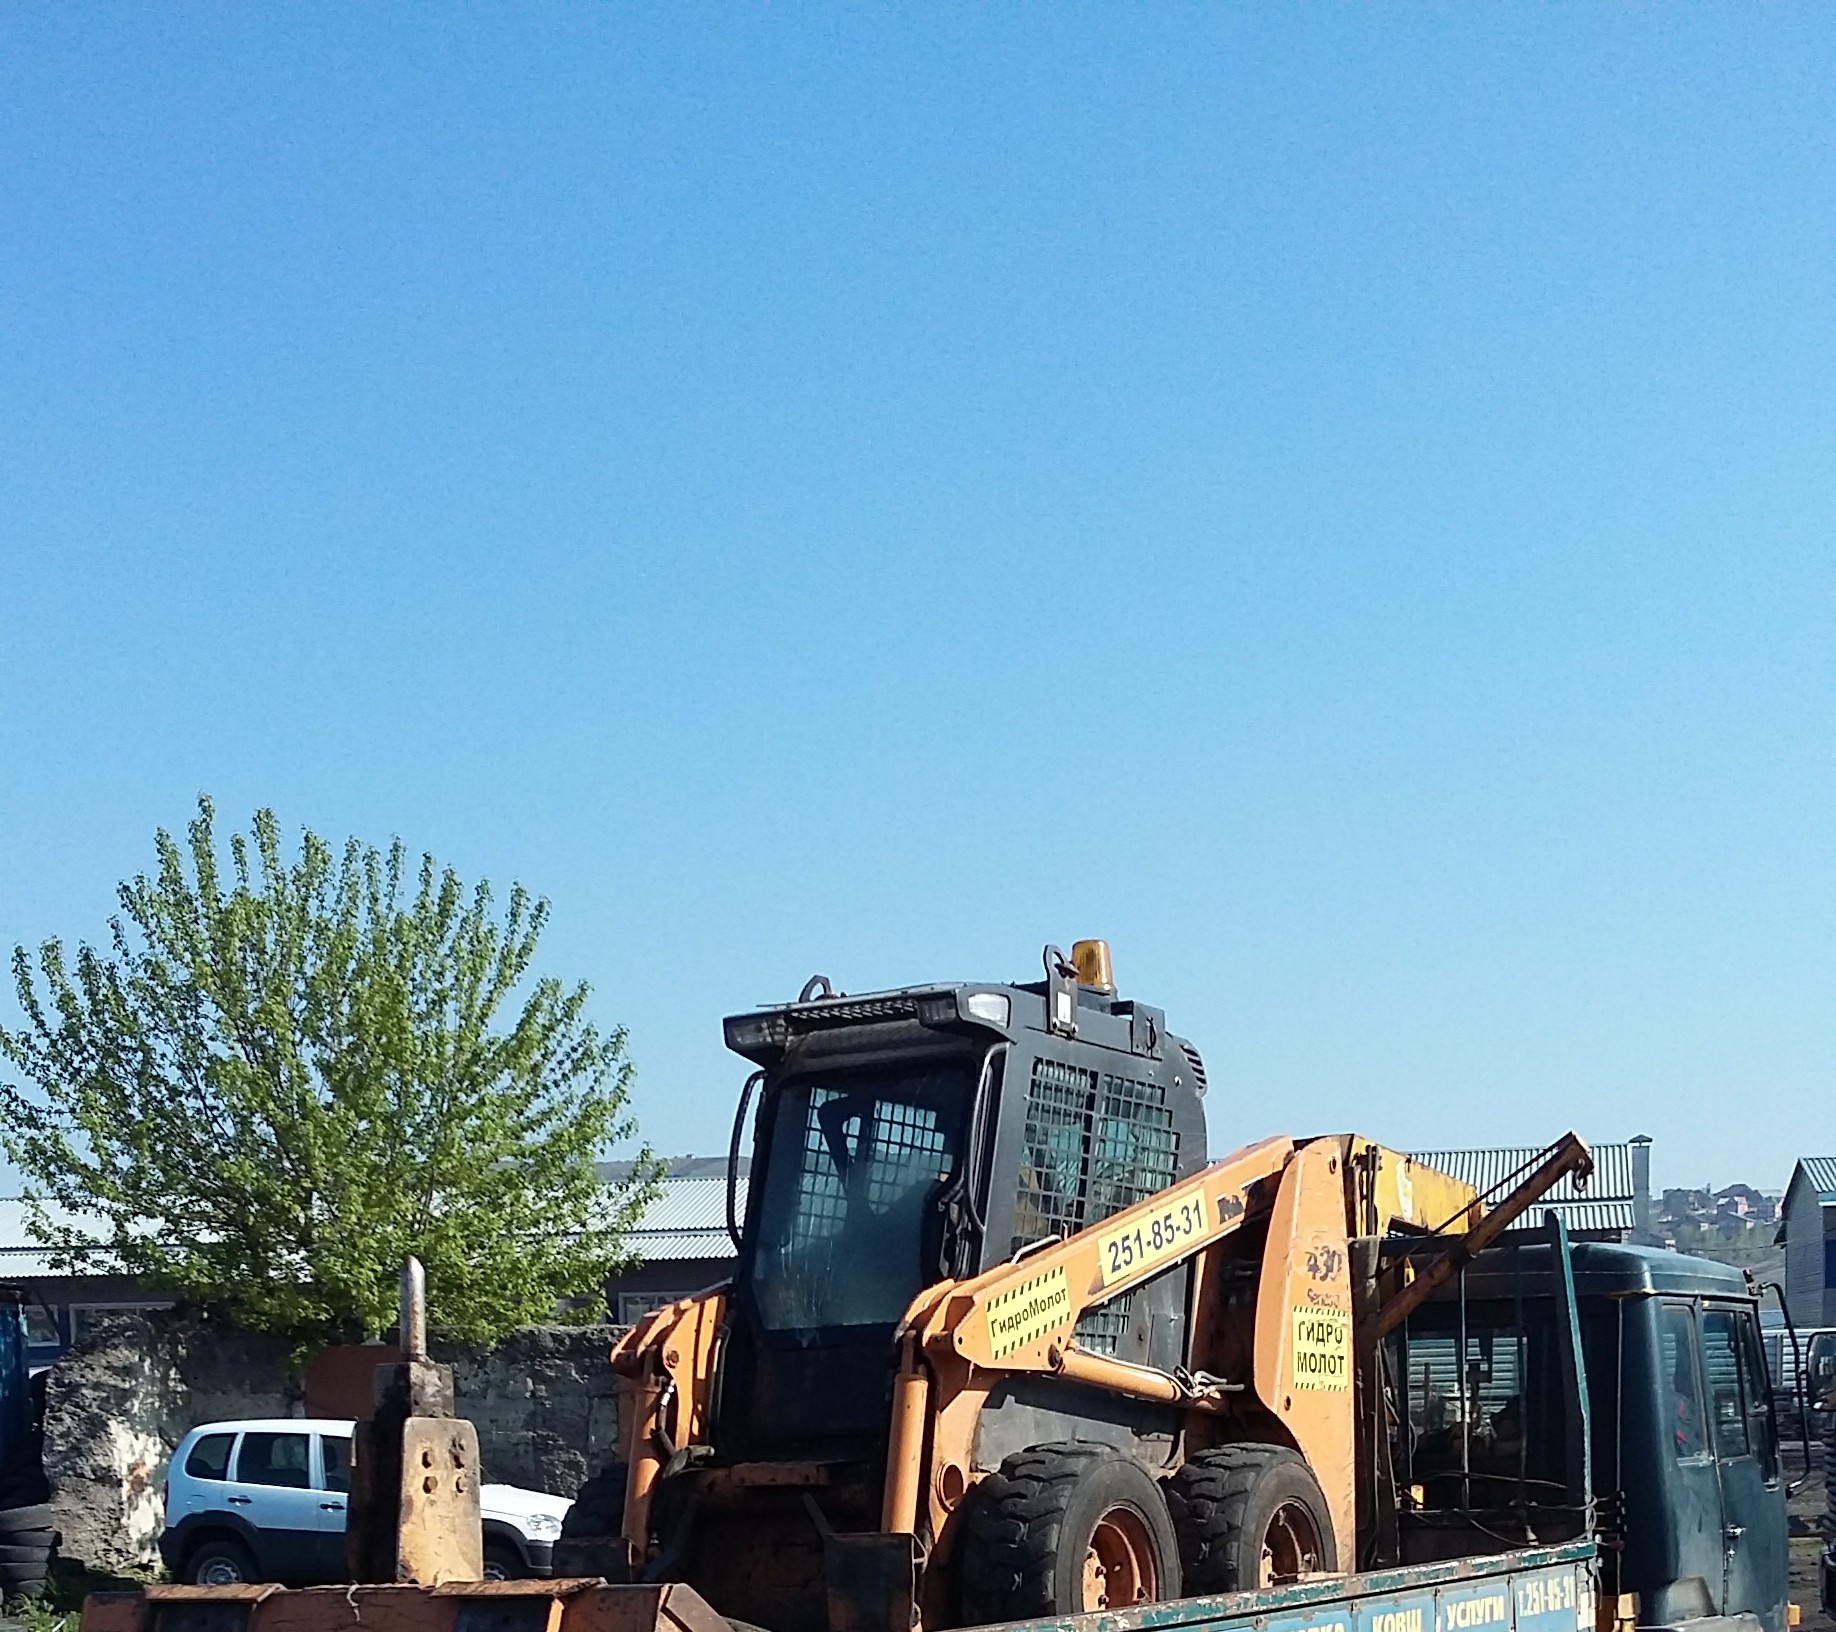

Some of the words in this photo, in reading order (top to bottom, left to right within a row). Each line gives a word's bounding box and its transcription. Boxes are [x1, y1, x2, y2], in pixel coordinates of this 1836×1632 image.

[1108, 1199, 1203, 1274] 251-85-31
[990, 1287, 1067, 1338] ГидроМолот
[1298, 1320, 1343, 1348] ГИДРО
[1297, 1351, 1345, 1375] МОЛОТ
[1446, 1595, 1505, 1631] УСЛУГИ
